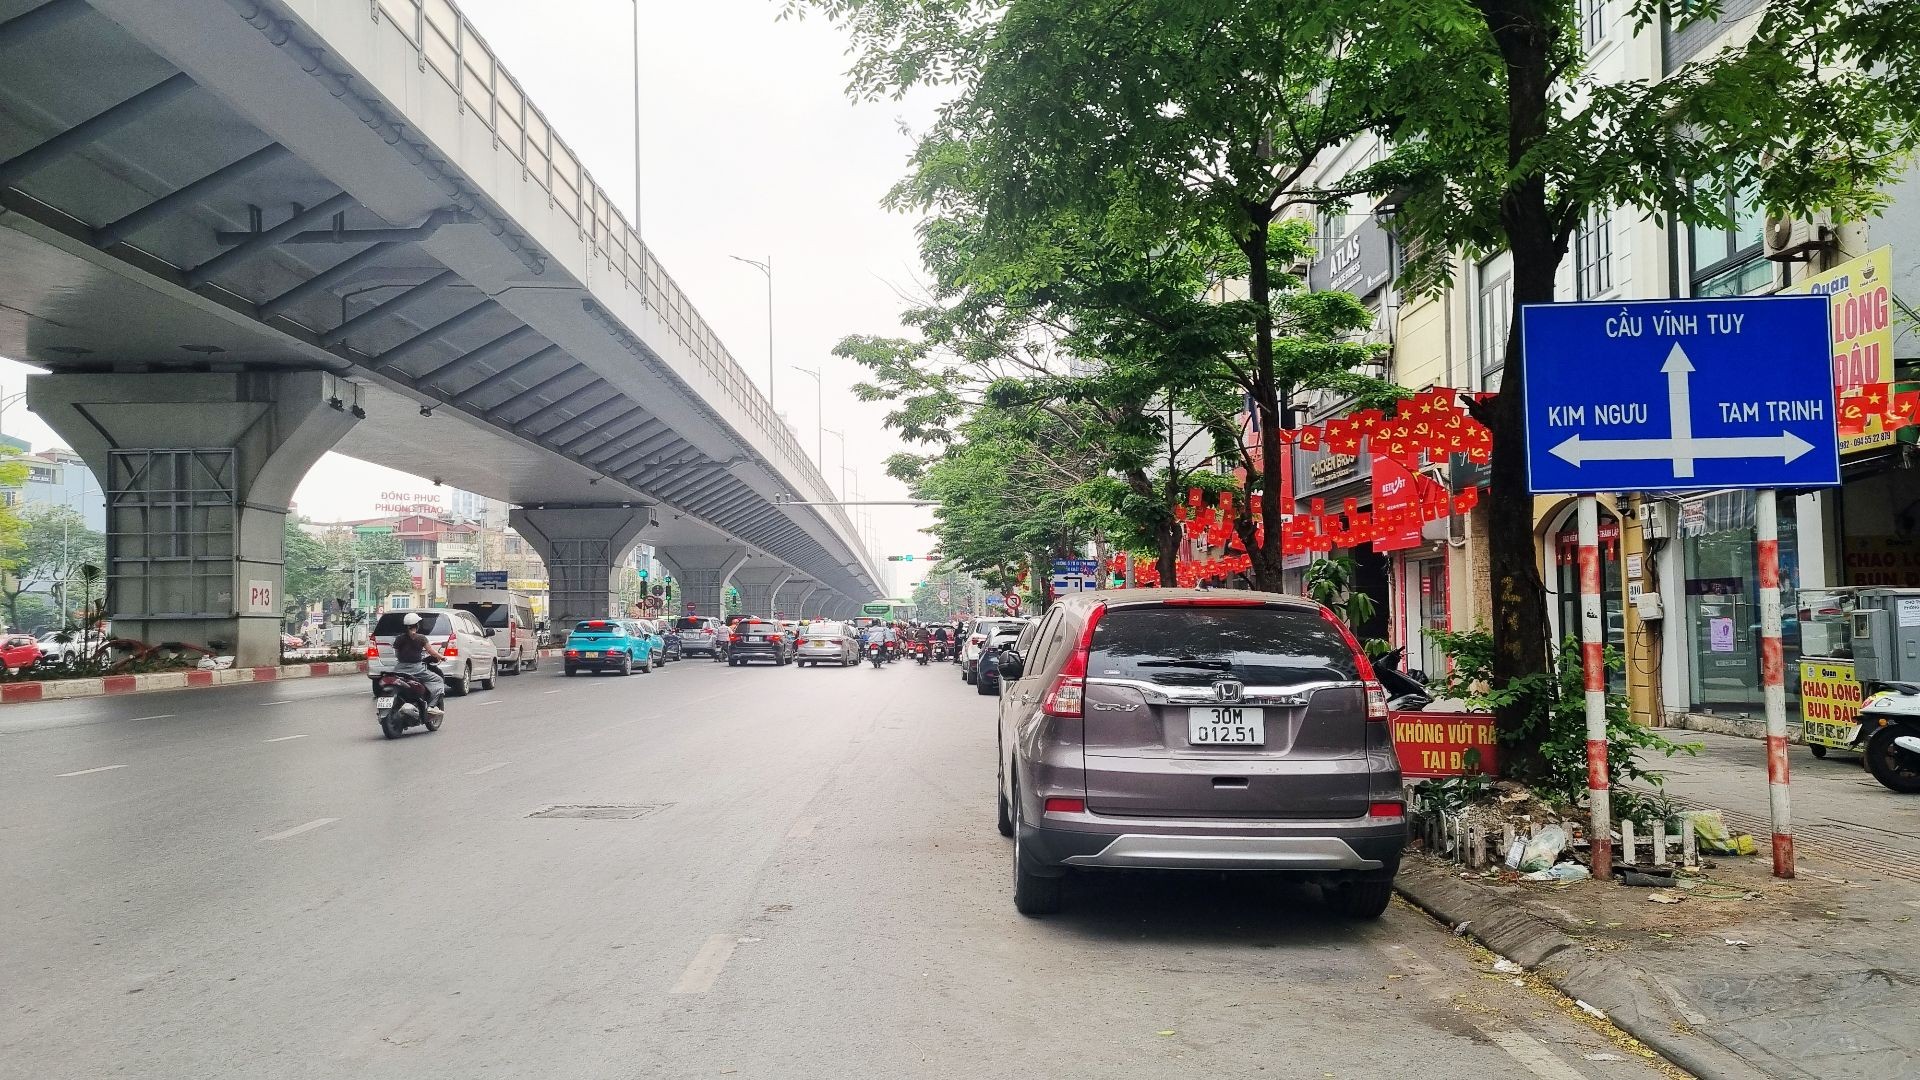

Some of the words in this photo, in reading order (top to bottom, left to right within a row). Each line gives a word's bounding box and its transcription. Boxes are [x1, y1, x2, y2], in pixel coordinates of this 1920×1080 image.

[1330, 234, 1360, 278] ATLAS
[1605, 307, 1643, 338] CẦU
[1652, 310, 1698, 336] VĨNH
[1707, 313, 1745, 334] TUY
[1834, 286, 1889, 344] LÒNG
[1834, 342, 1880, 397] ĐẬU
[1548, 405, 1585, 427] KIM
[1594, 403, 1648, 426] NGƯU
[1718, 401, 1760, 423] TAM
[1766, 399, 1825, 422] TRINH
[252, 587, 270, 606] P13
[1092, 702, 1141, 713] CR-V
[1211, 708, 1243, 725] 30M
[1198, 727, 1255, 742] 012.51
[1395, 719, 1444, 743] KHÔNG
[1447, 720, 1474, 744] VỨT
[1478, 720, 1497, 745] RÁ
[1421, 750, 1446, 773] TẠI
